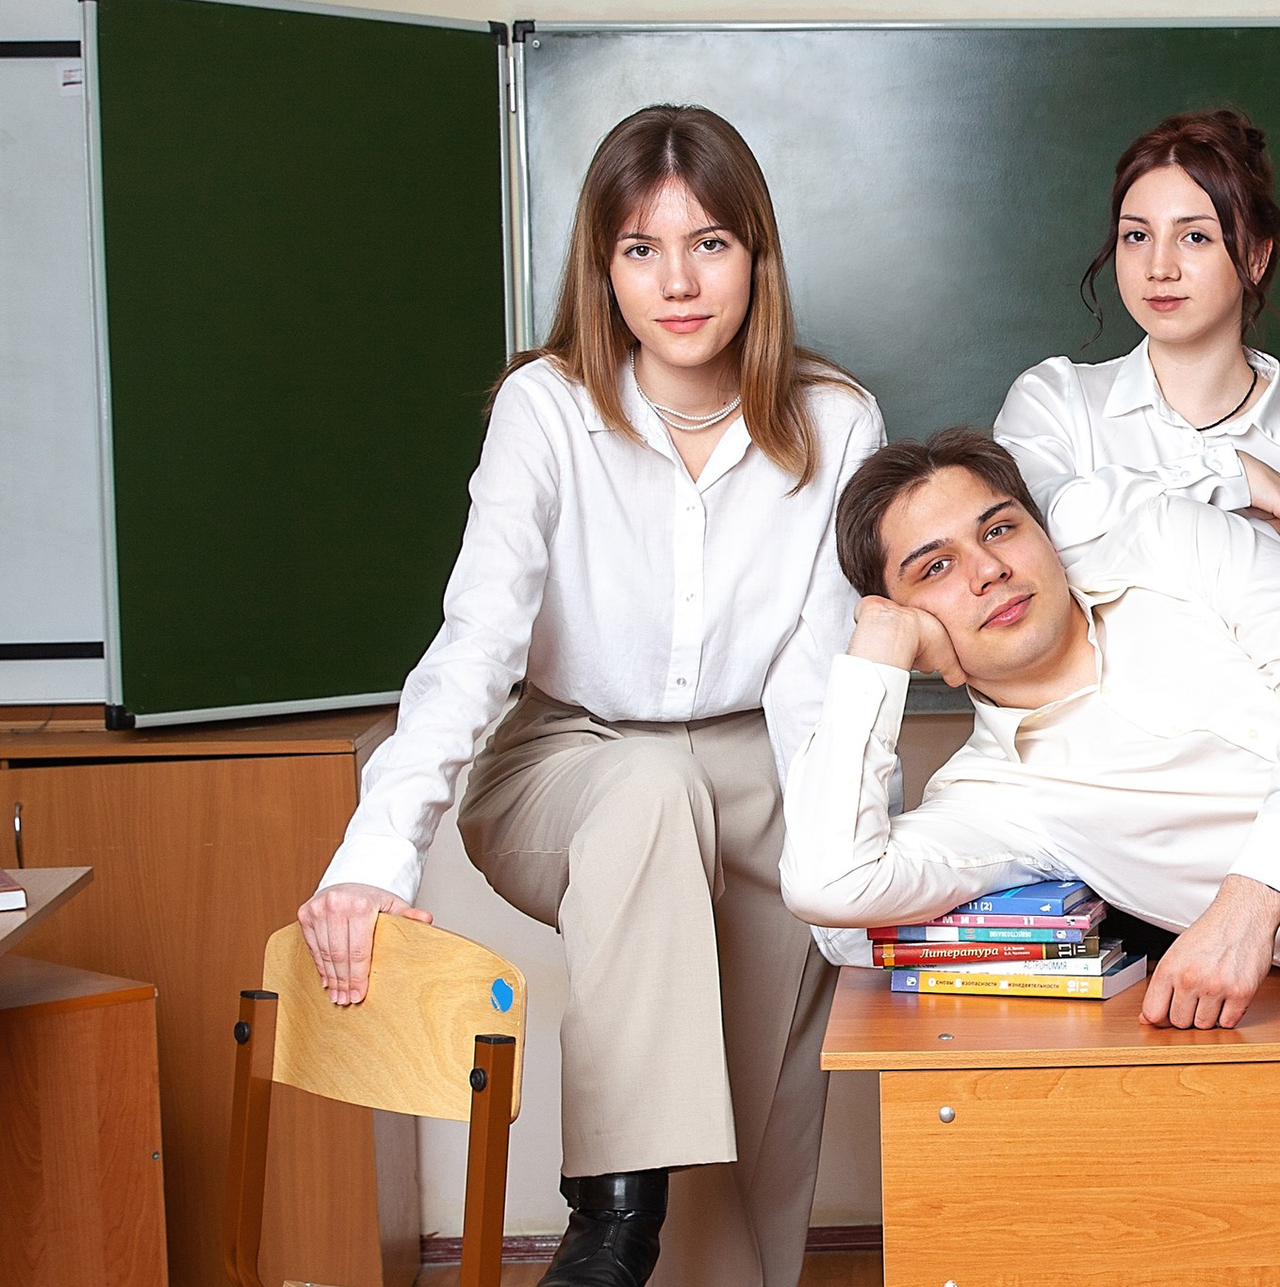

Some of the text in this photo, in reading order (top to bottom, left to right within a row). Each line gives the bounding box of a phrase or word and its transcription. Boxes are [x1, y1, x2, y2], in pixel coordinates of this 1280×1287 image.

[968, 902, 993, 911] 11 (2)
[1023, 917, 1034, 925] 11
[920, 947, 999, 959] Литература
[1058, 943, 1072, 957] 11
[1080, 981, 1089, 993] 11
